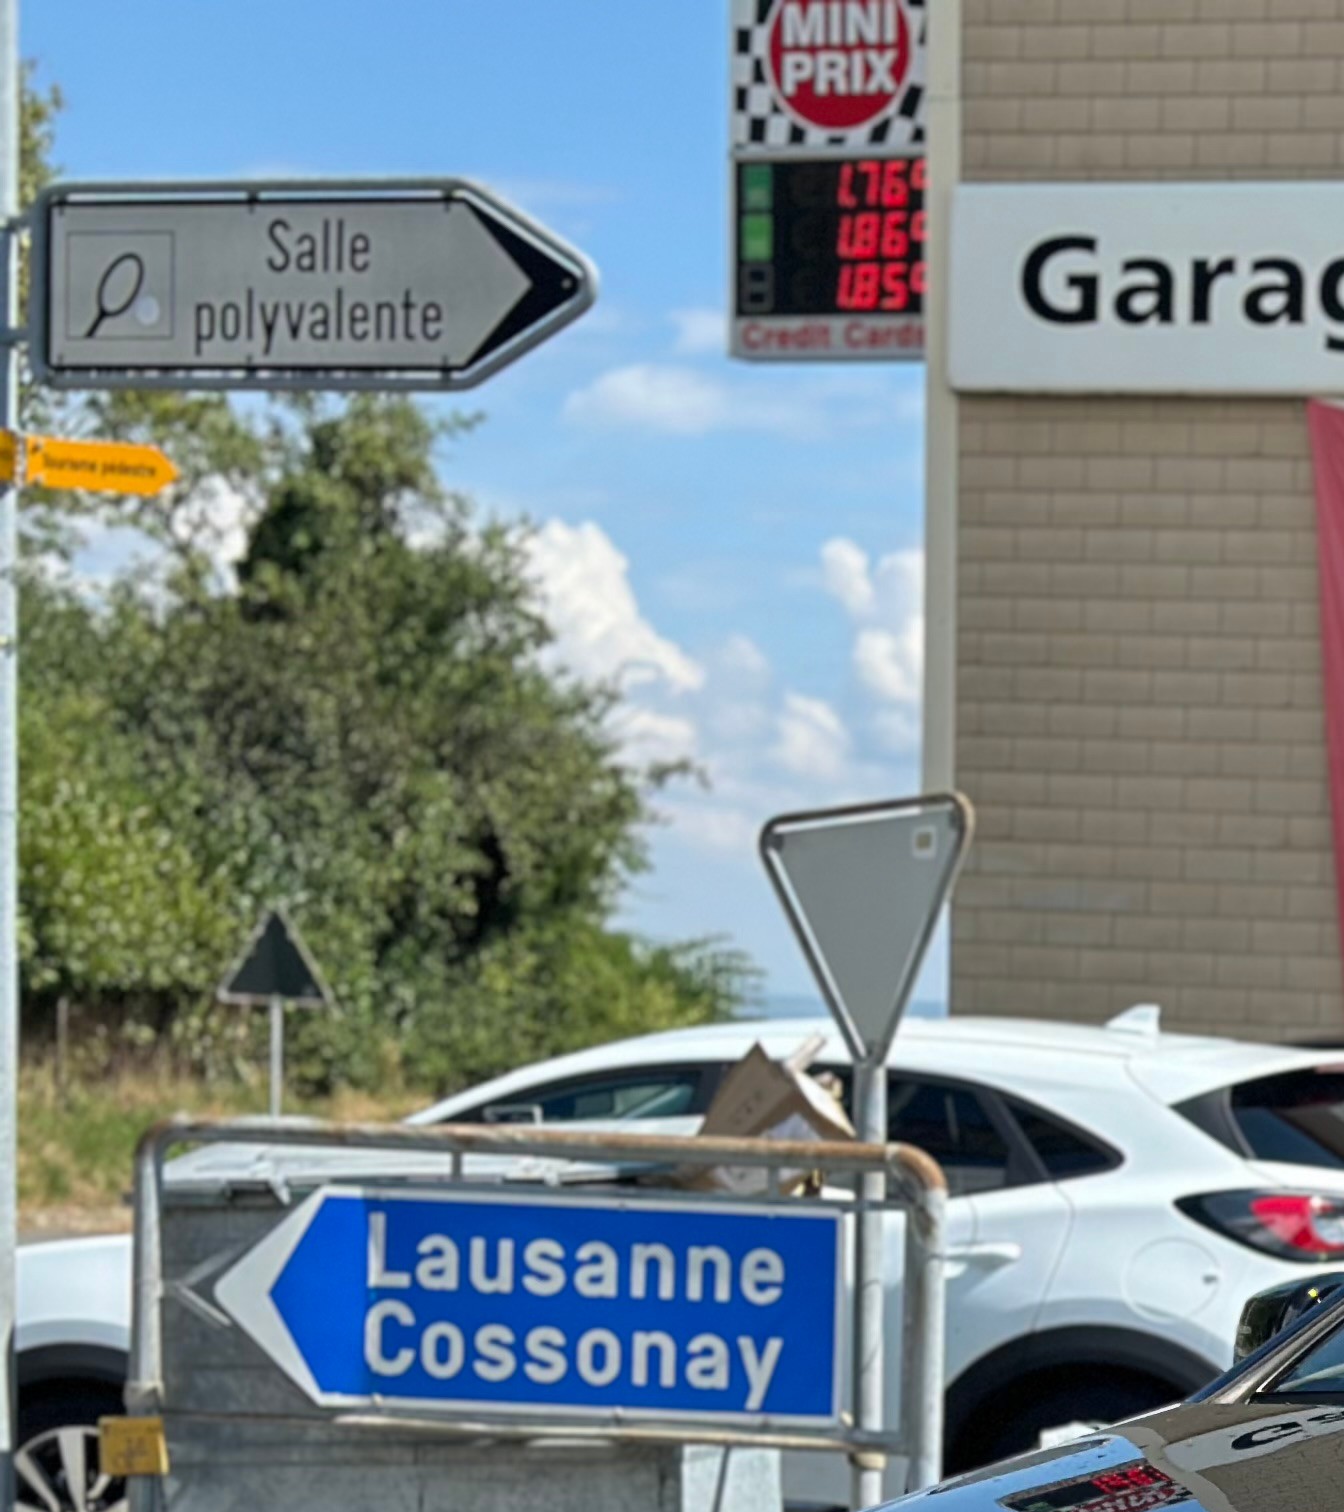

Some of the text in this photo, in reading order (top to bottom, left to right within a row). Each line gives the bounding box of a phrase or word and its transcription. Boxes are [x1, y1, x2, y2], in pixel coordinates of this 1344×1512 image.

[783, 0, 898, 46] MINI
[783, 50, 898, 96] PRIX
[267, 218, 371, 273] Salle
[194, 288, 443, 356] polyvalente
[741, 322, 830, 349] Credit
[365, 1211, 785, 1306] Lausanne
[362, 1298, 784, 1412] Cossonay
